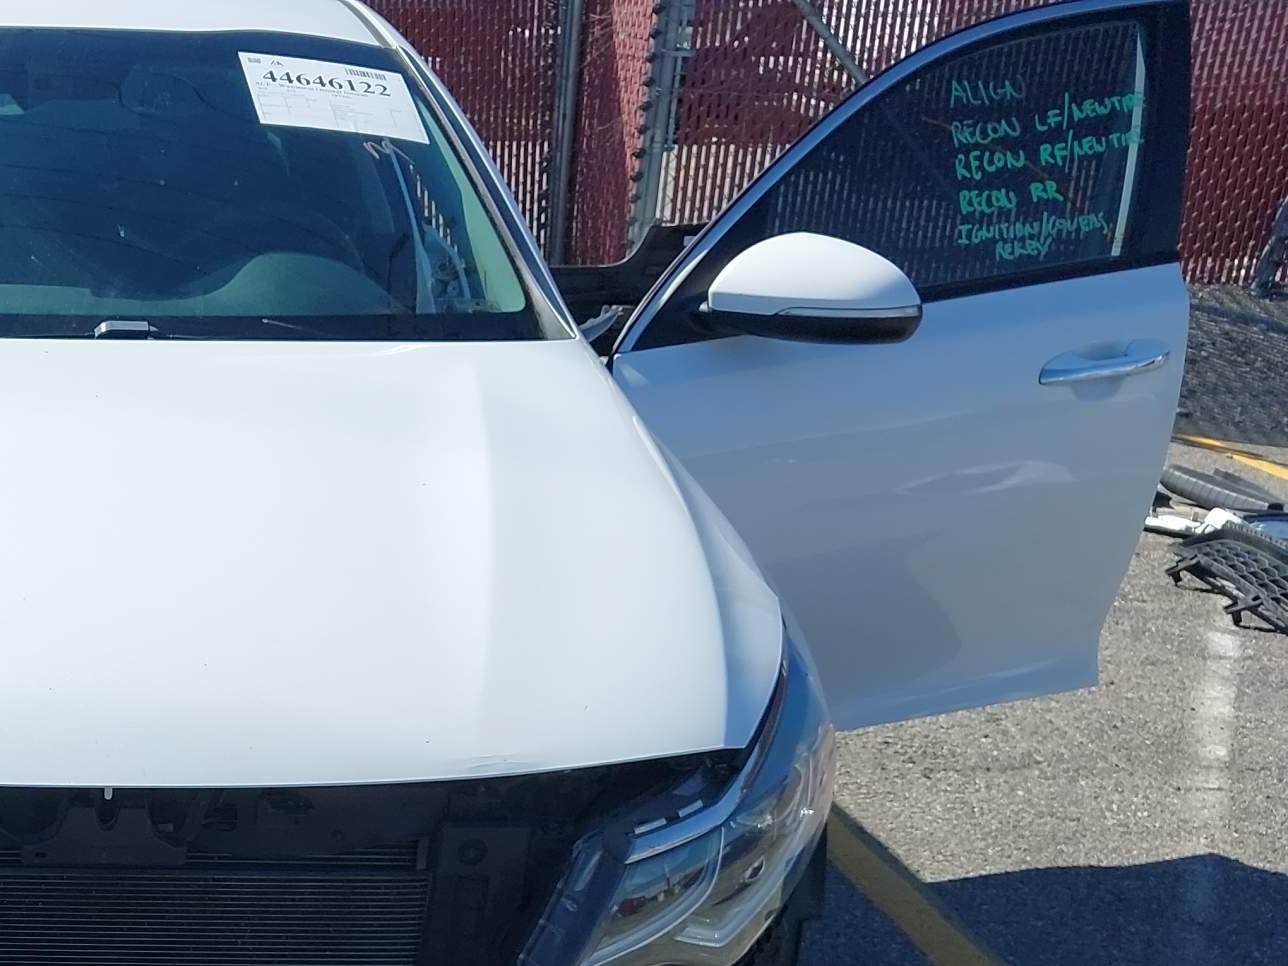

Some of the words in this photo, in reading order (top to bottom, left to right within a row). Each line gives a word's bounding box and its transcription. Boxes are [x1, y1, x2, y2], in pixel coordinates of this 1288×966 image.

[263, 69, 391, 97] 44646122
[950, 75, 1025, 108] ALIGN
[951, 118, 1021, 147] RECON
[955, 149, 1026, 181] RECON
[959, 188, 1017, 215] RECON
[1030, 181, 1063, 202] RR
